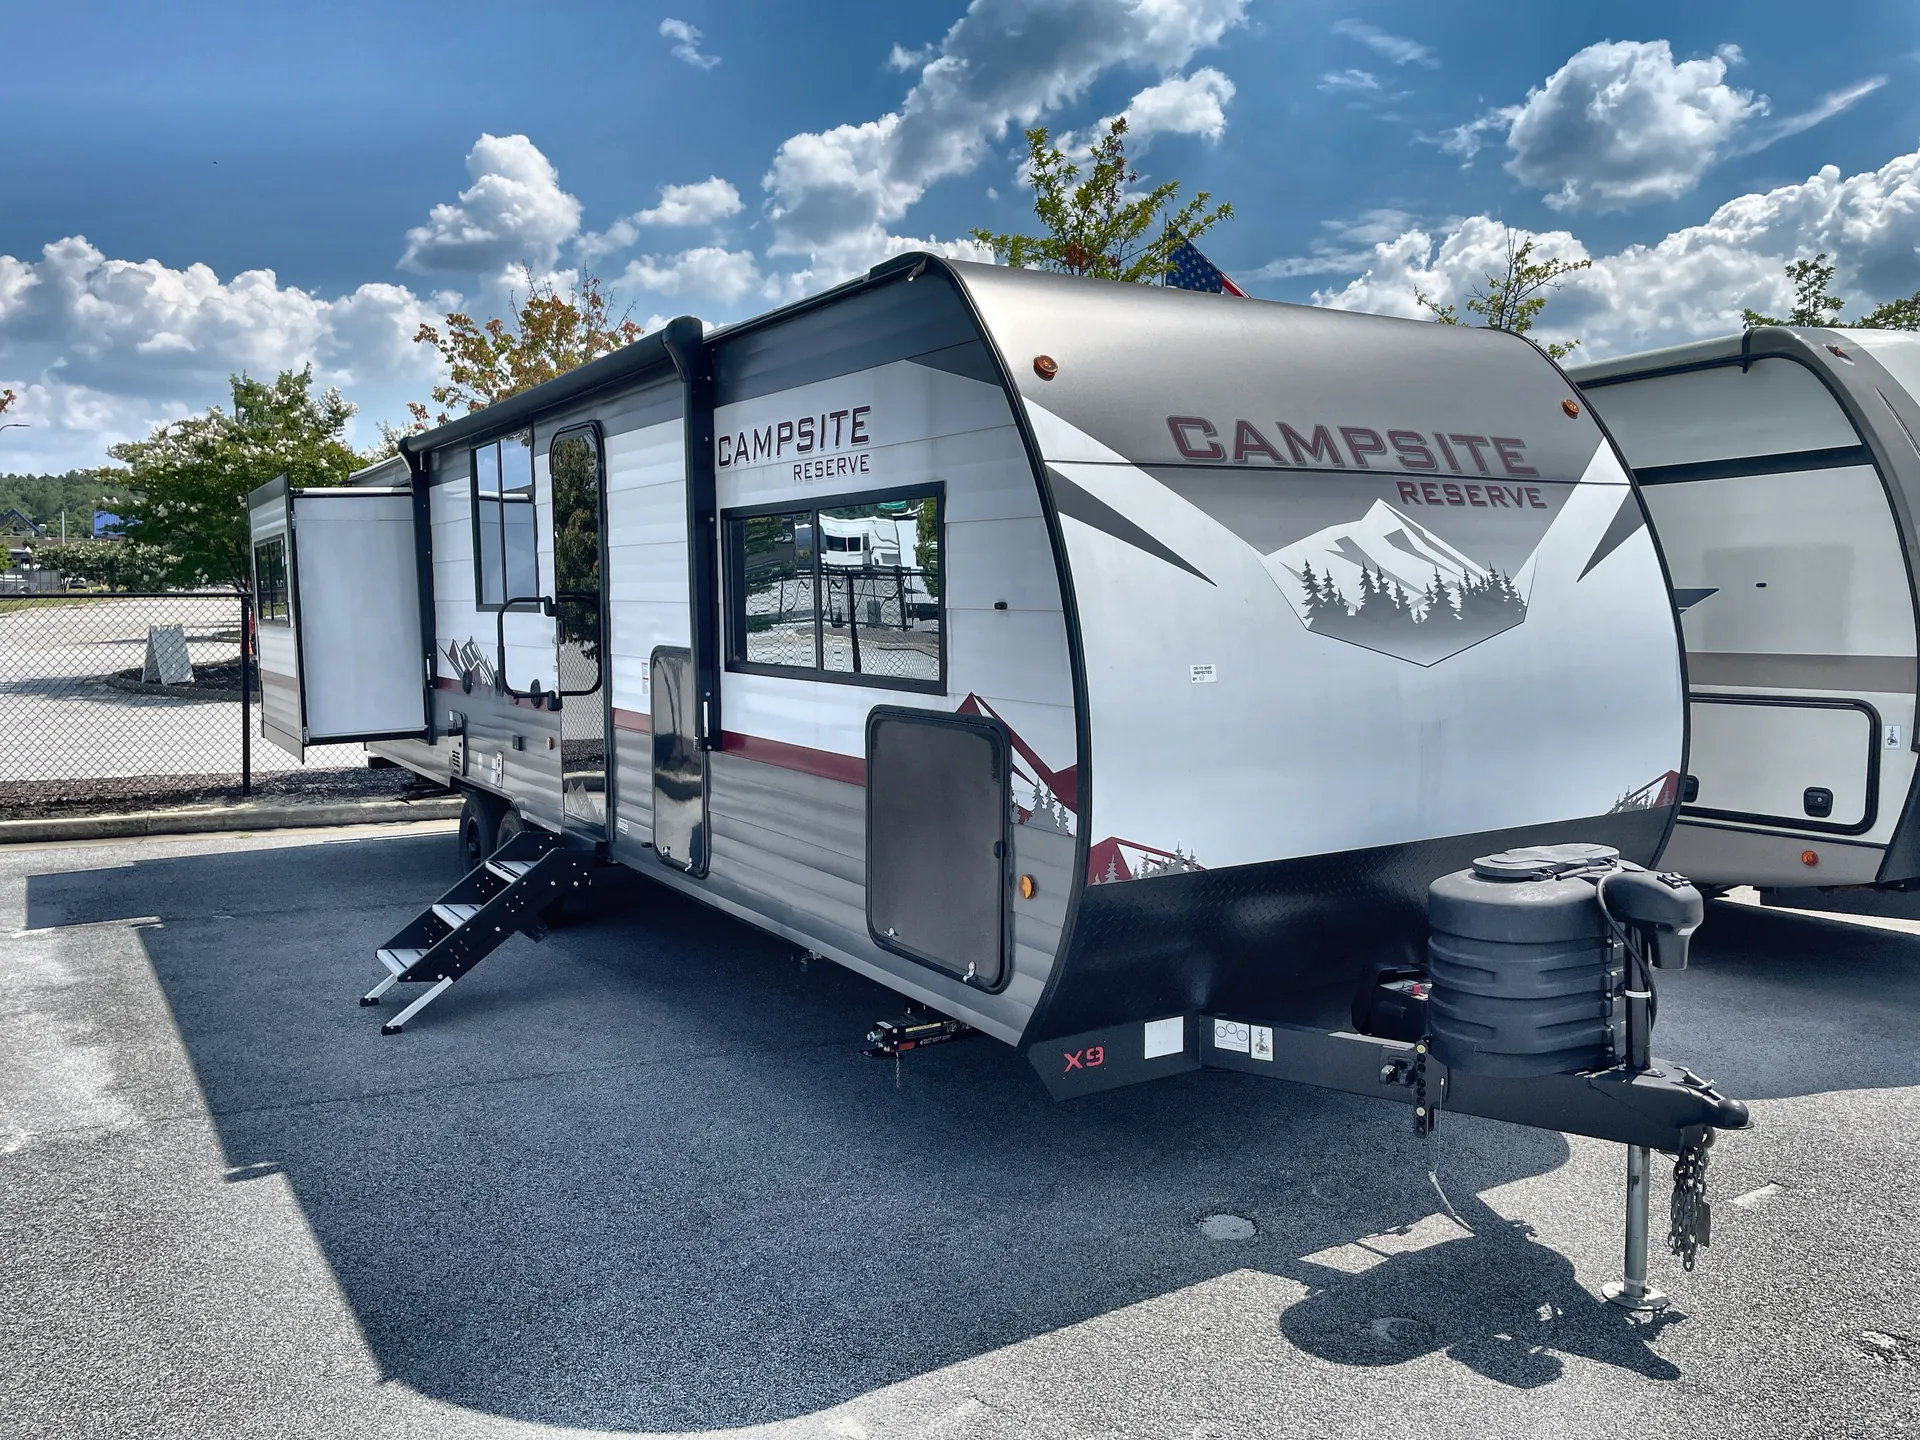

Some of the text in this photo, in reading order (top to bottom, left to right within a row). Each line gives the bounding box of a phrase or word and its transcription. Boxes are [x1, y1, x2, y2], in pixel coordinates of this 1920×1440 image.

[718, 405, 871, 468] CAMPSITE
[1166, 414, 1540, 477] CAMPSITE
[793, 454, 870, 481] RESERVE
[1396, 480, 1548, 509] RESERVE
[1063, 1046, 1104, 1073] X9
